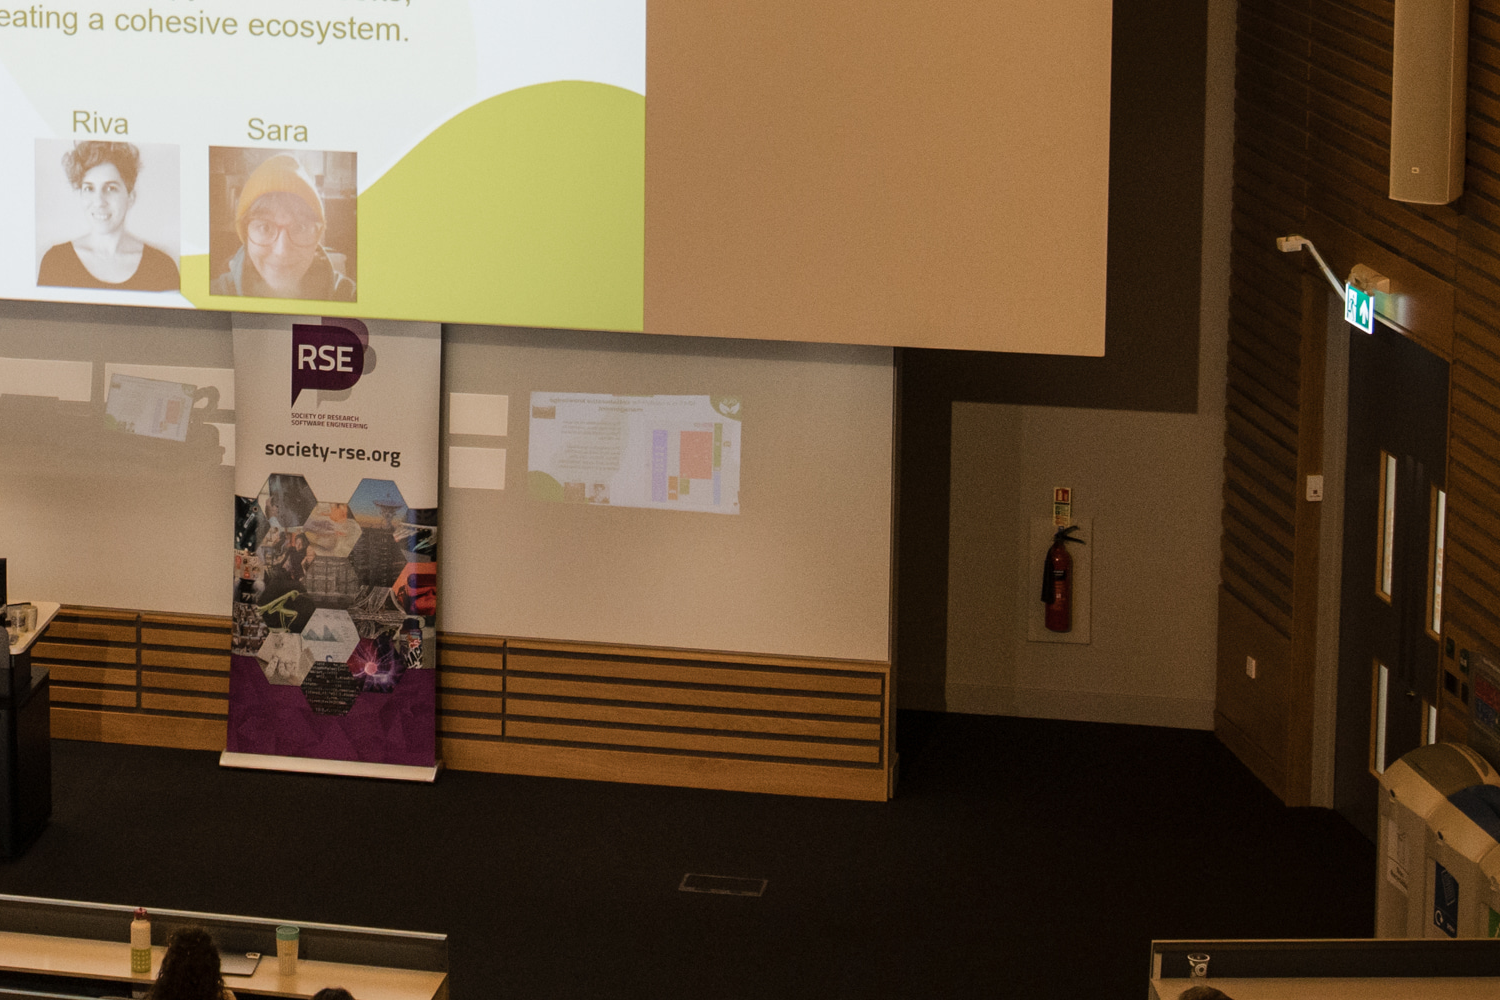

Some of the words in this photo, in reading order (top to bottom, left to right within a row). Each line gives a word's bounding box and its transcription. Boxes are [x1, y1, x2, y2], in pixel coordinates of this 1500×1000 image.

[88, 12, 104, 31] a
[114, 8, 238, 36] cohesive
[248, 16, 409, 45] ecosystem.
[72, 110, 128, 134] Riva
[247, 117, 308, 142] Sara
[297, 344, 353, 372] RSE
[291, 412, 317, 420] SOCIETY
[327, 414, 360, 422] RESEARCH
[291, 420, 325, 428] SOFTWARE
[326, 421, 368, 430] ENGINEERING
[265, 441, 401, 468] society-rse.org
